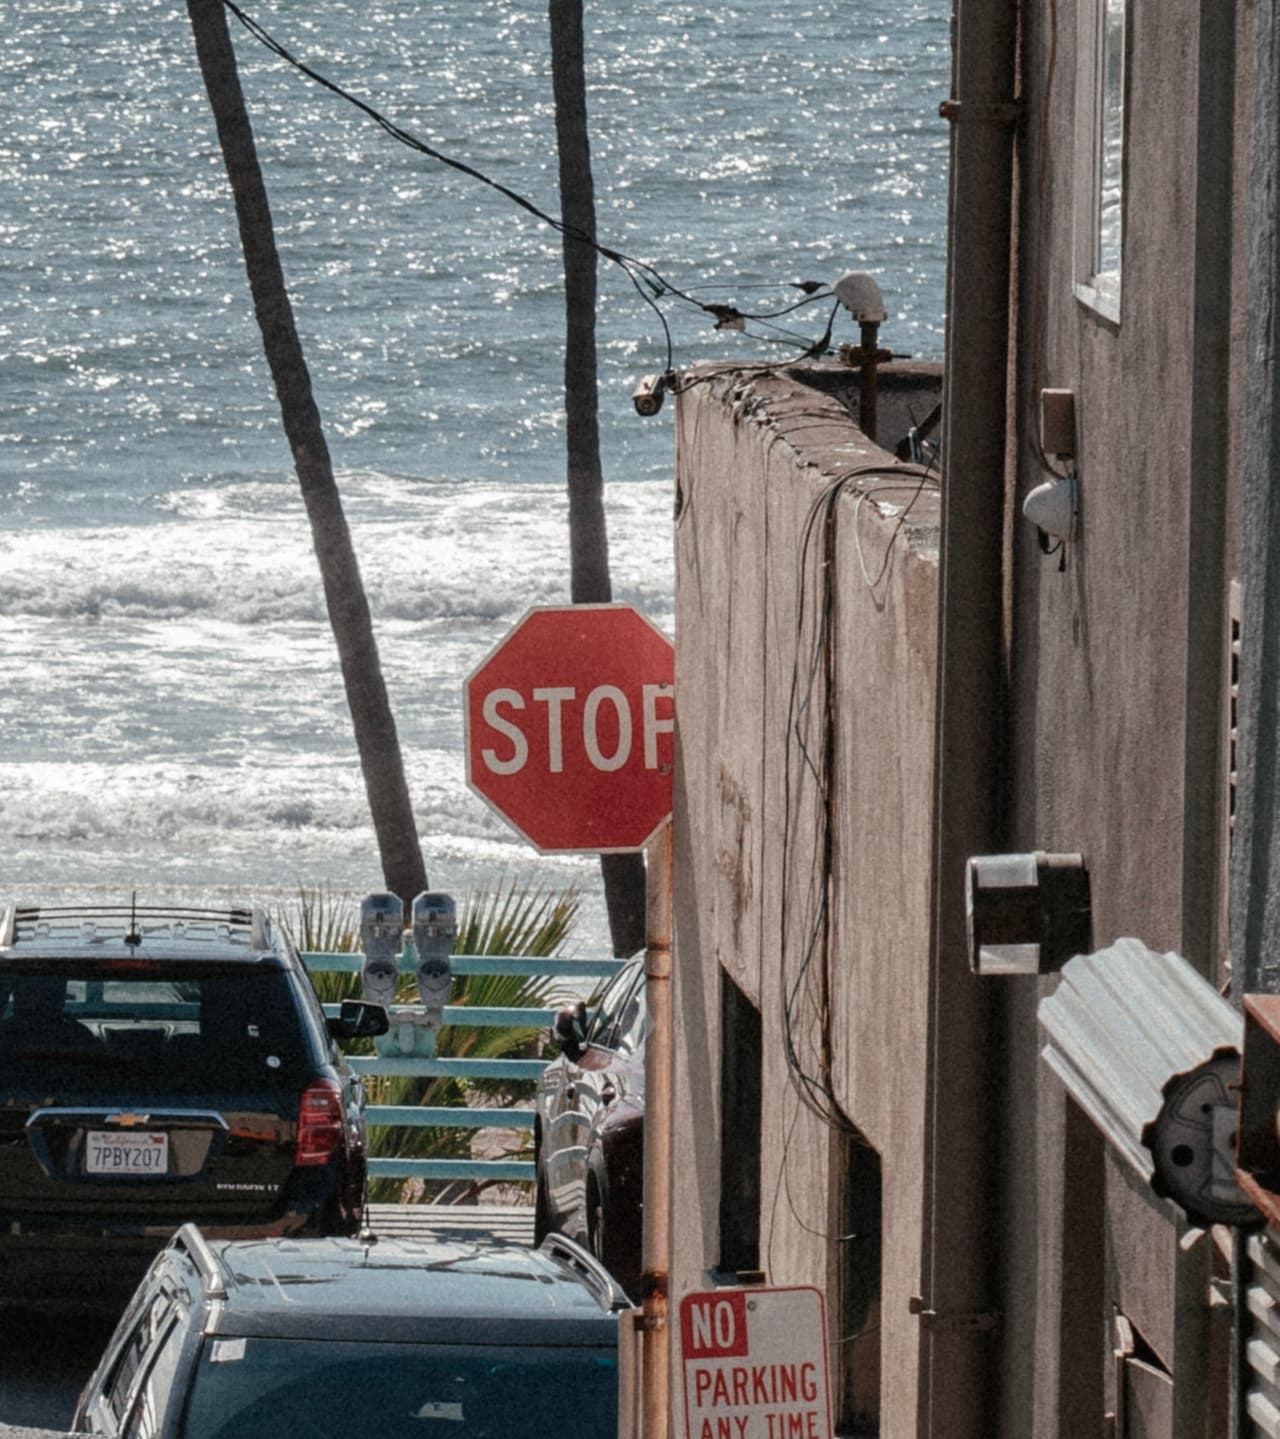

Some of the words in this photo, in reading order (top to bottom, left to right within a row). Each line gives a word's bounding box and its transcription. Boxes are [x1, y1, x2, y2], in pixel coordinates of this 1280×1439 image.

[481, 684, 675, 775] STOP
[92, 1146, 162, 1167] 7PBY207
[691, 1301, 735, 1350] NO
[695, 1363, 817, 1408] PARKING
